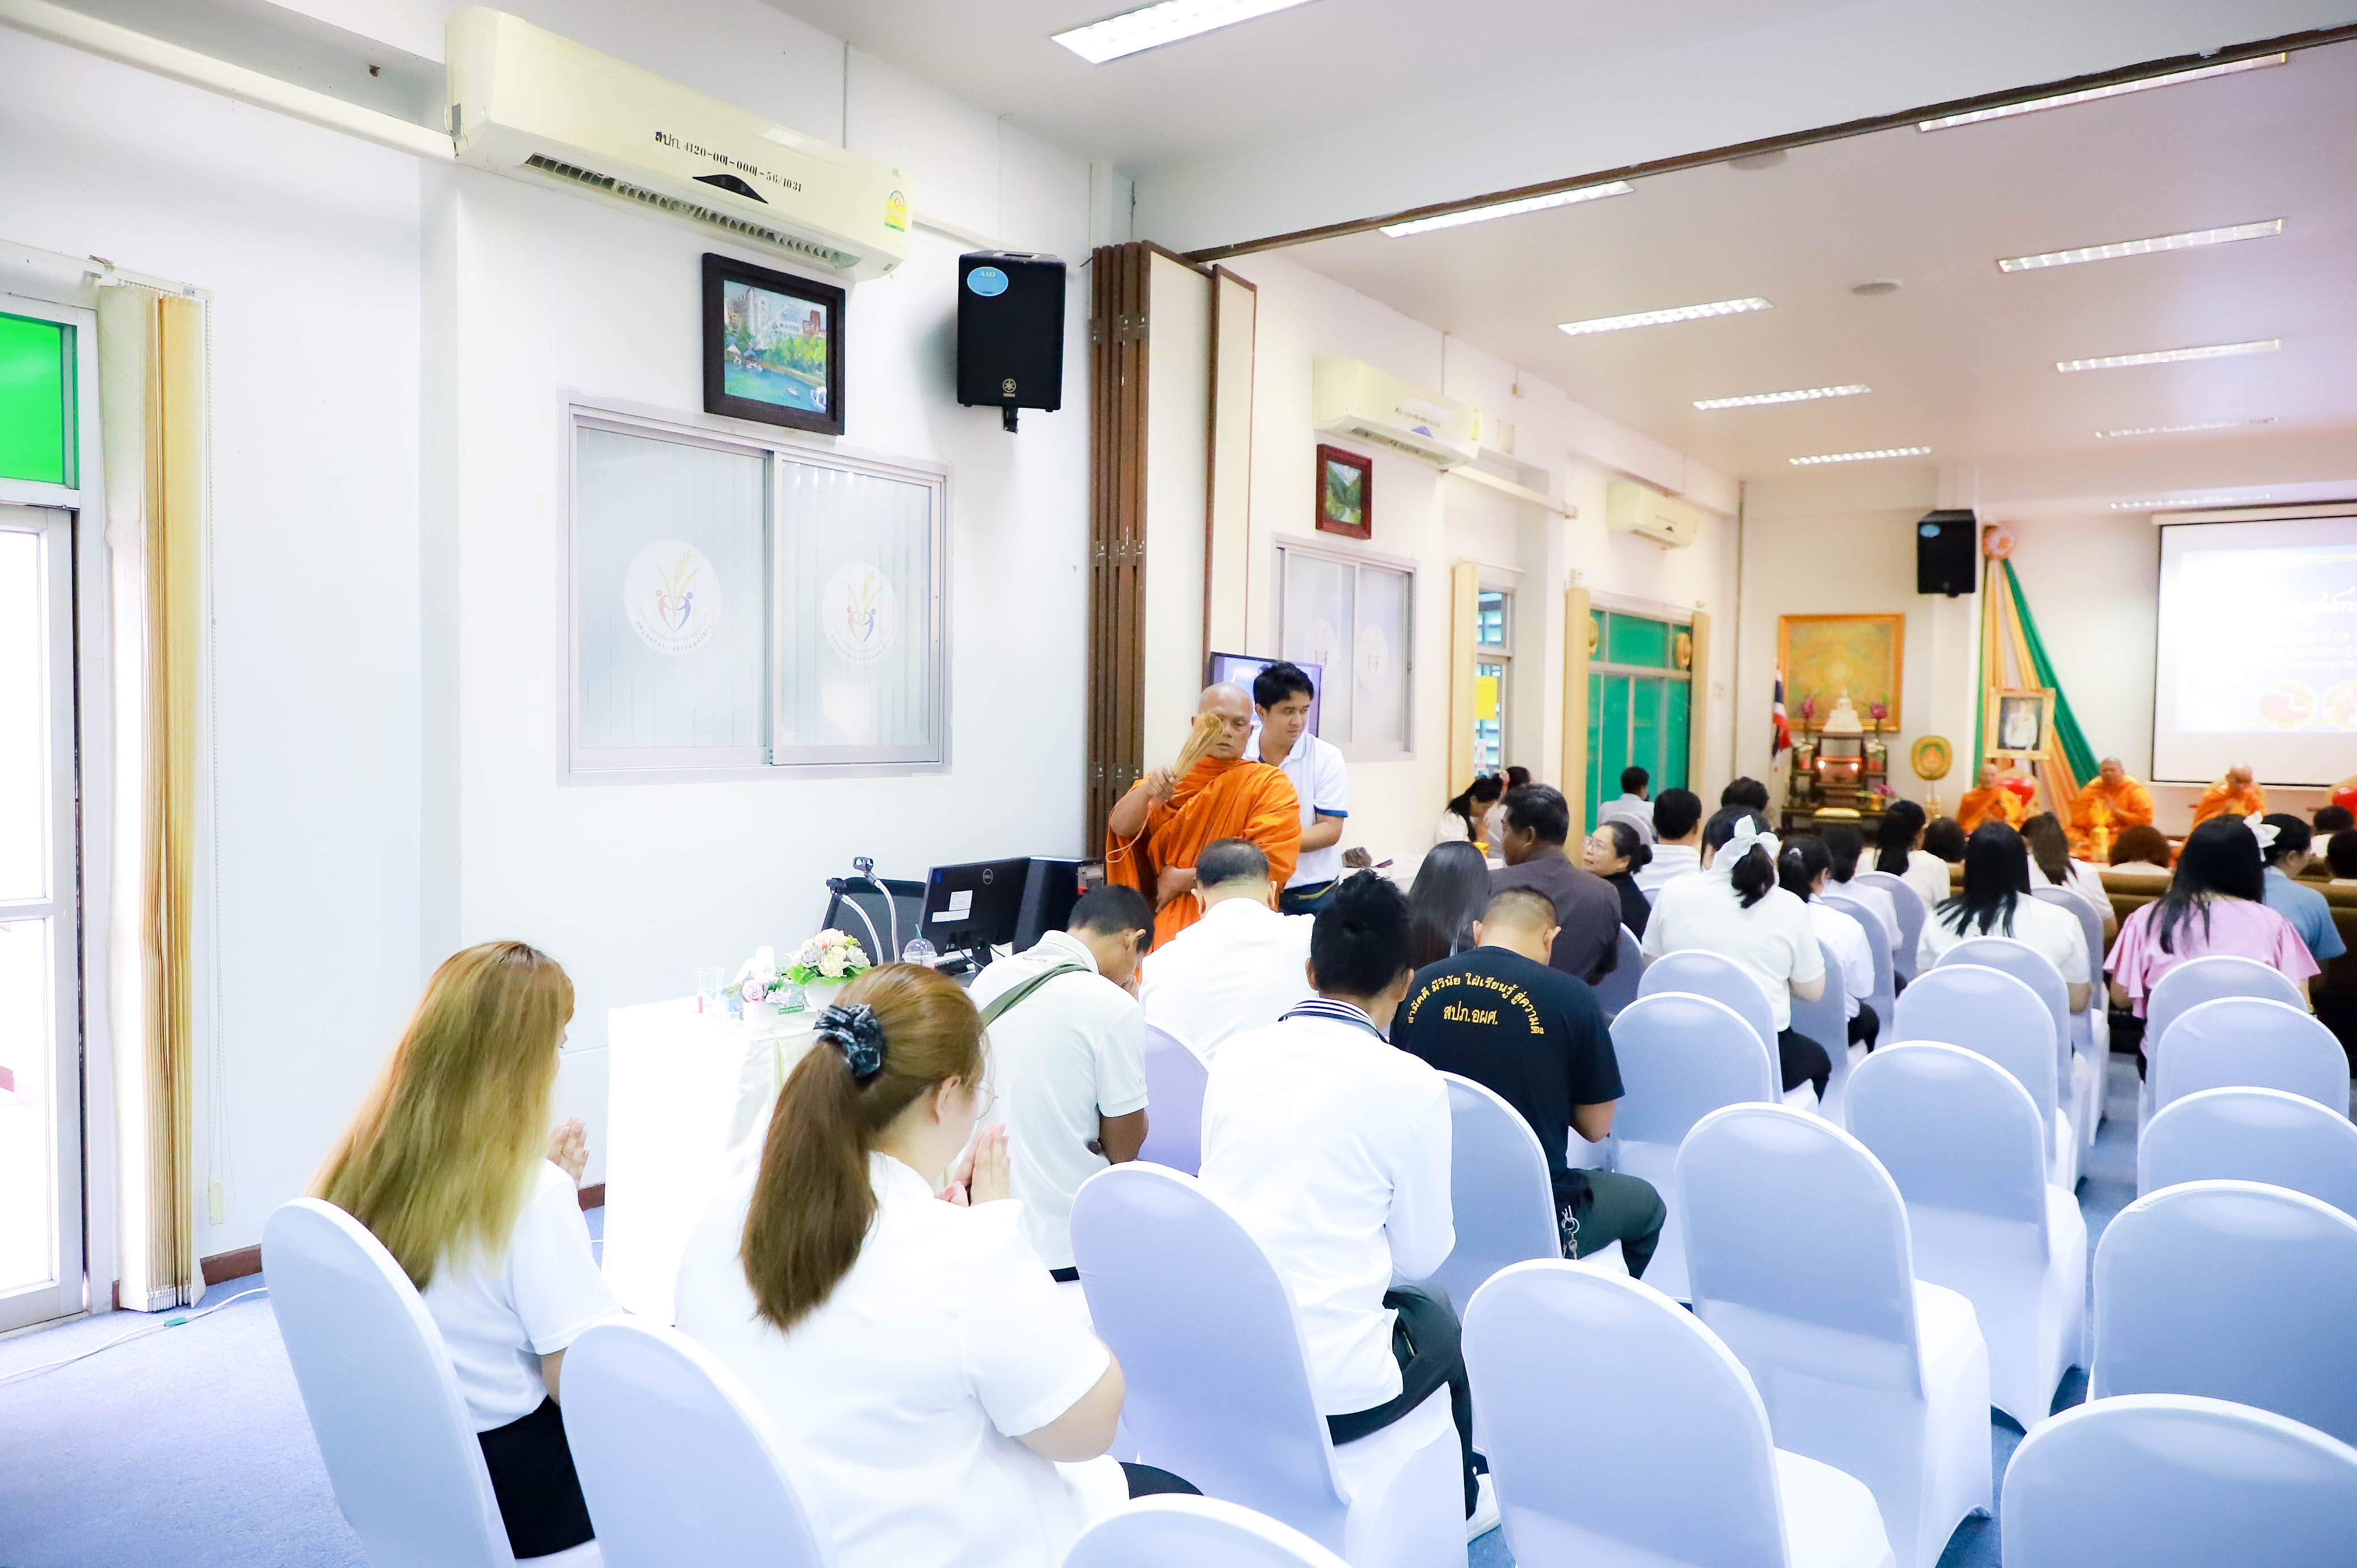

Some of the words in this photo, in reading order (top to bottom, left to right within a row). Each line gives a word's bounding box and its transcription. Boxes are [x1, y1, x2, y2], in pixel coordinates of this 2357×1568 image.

[1408, 986, 1431, 1024] สามัคคี
[1431, 974, 1461, 992] มีวินัย
[1465, 972, 1519, 999] ใฝ่เรียนรู้
[1511, 991, 1545, 1034] สู่ความดี
